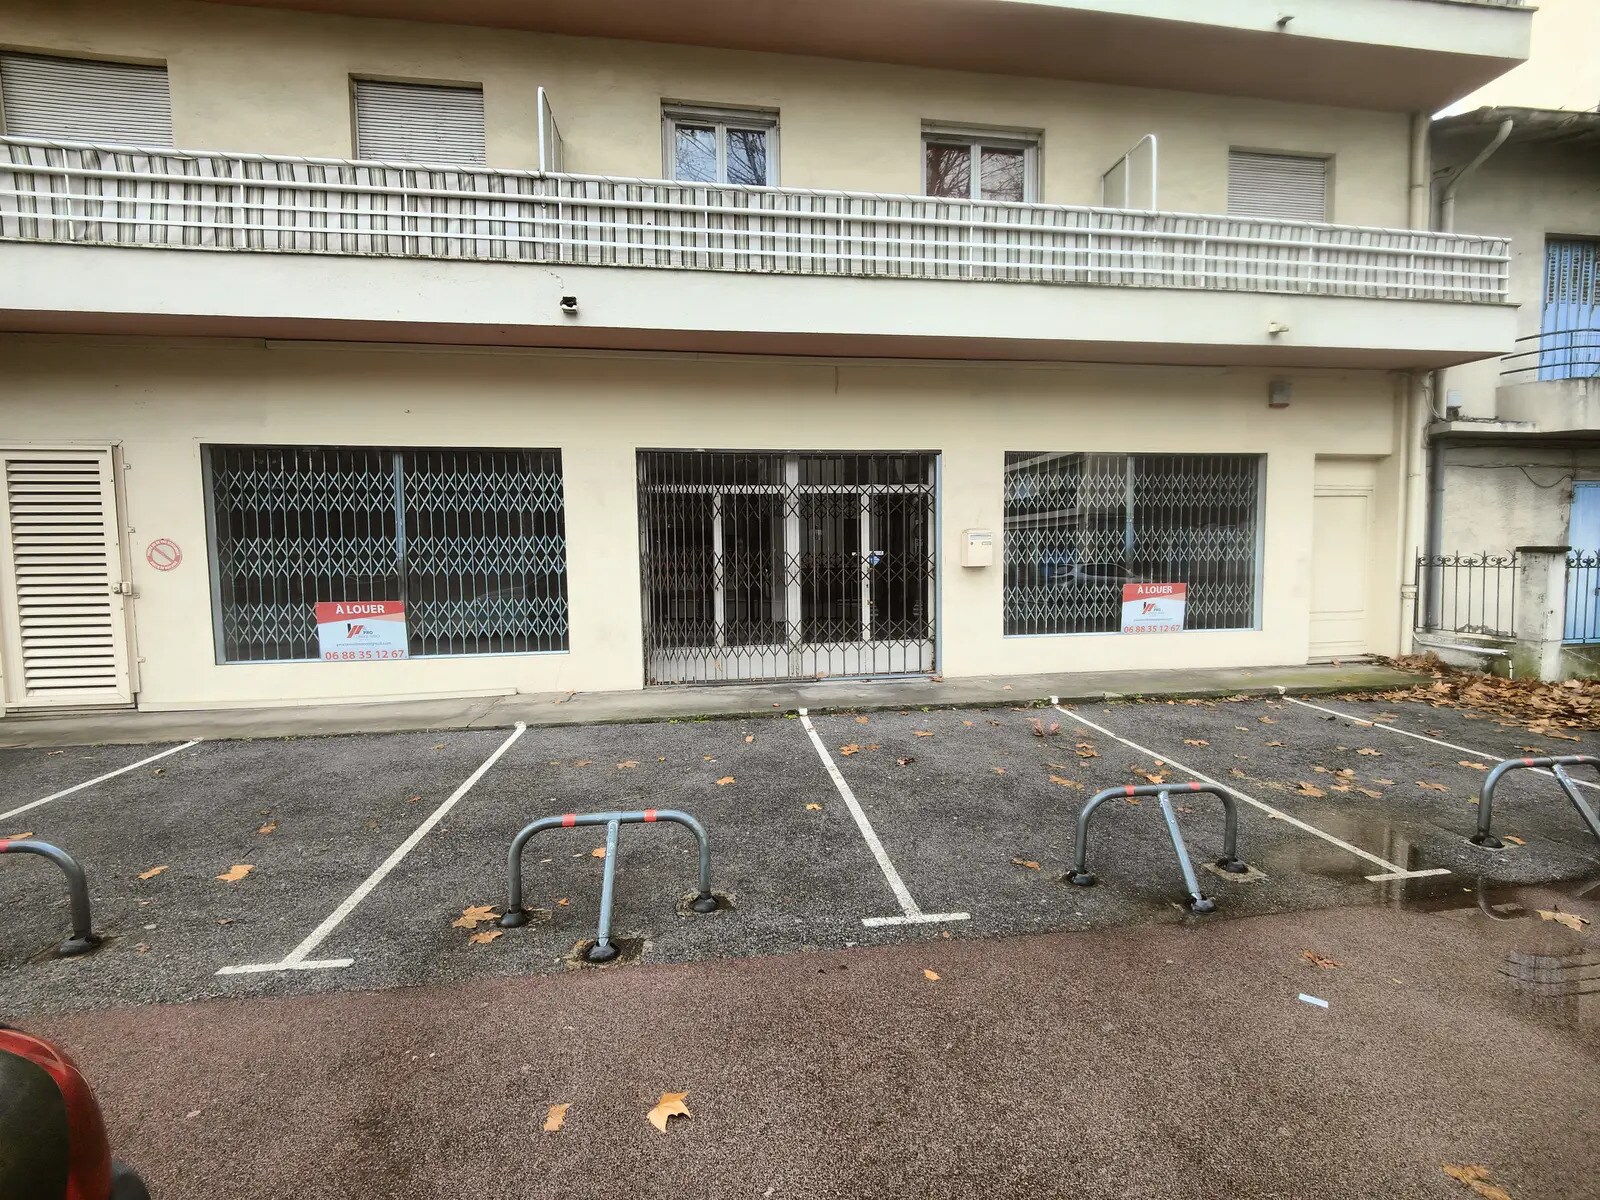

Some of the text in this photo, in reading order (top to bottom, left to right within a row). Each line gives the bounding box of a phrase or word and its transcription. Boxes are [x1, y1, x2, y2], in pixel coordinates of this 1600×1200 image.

[336, 604, 385, 614] À LOUER
[1147, 625, 1157, 633] 35
[1160, 625, 1169, 633] 12
[325, 649, 404, 660] 06 88 35 12 67
